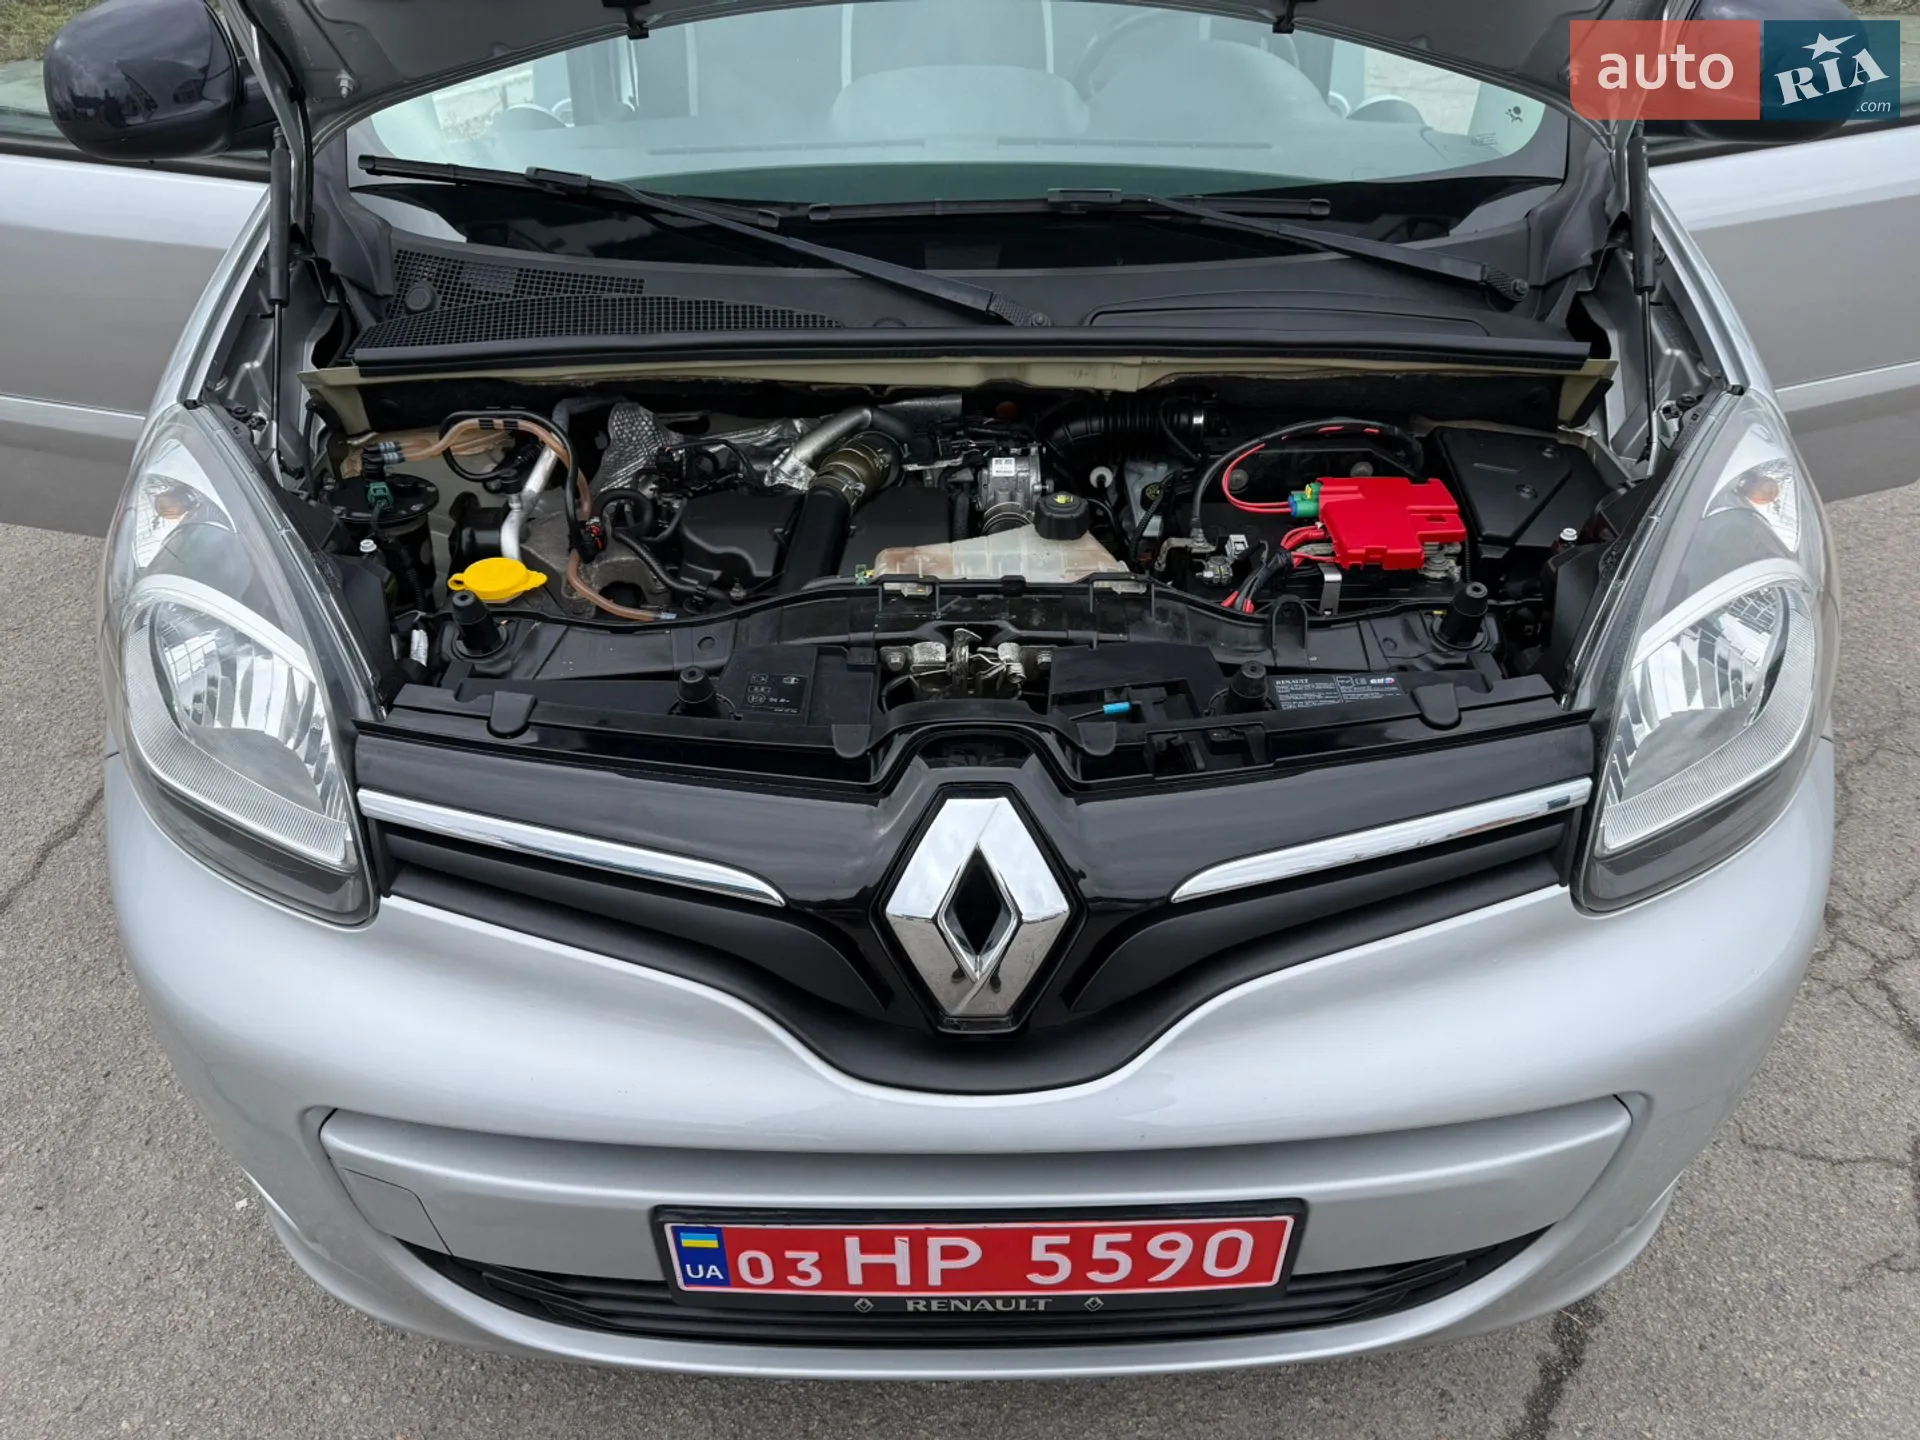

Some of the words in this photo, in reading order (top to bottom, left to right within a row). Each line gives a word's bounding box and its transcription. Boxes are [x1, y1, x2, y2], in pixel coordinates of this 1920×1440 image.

[737, 1249, 823, 1287] 03
[844, 1236, 983, 1287] HP
[1026, 1229, 1254, 1285] 5590
[685, 1263, 724, 1280] UA
[906, 1299, 1053, 1312] RENAULT
